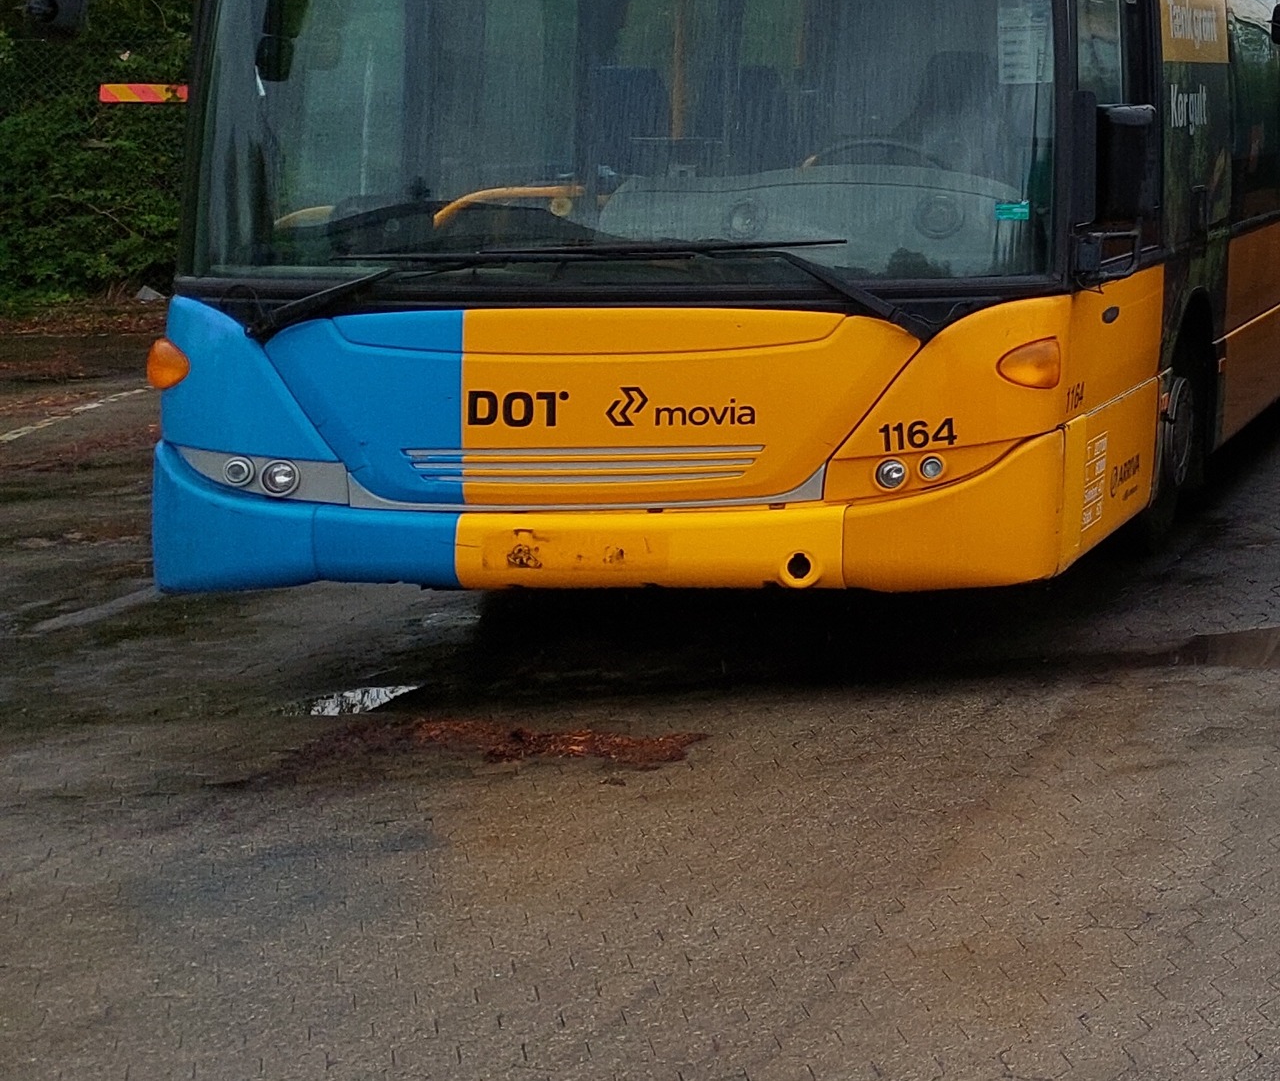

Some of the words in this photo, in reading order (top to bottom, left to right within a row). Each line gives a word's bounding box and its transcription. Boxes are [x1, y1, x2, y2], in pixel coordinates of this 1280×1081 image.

[1170, 84, 1189, 128] Kør
[1189, 85, 1207, 136] gult
[467, 390, 570, 427] DOT
[655, 398, 756, 426] movia
[1066, 381, 1085, 413] 1164
[878, 417, 958, 452] 1164
